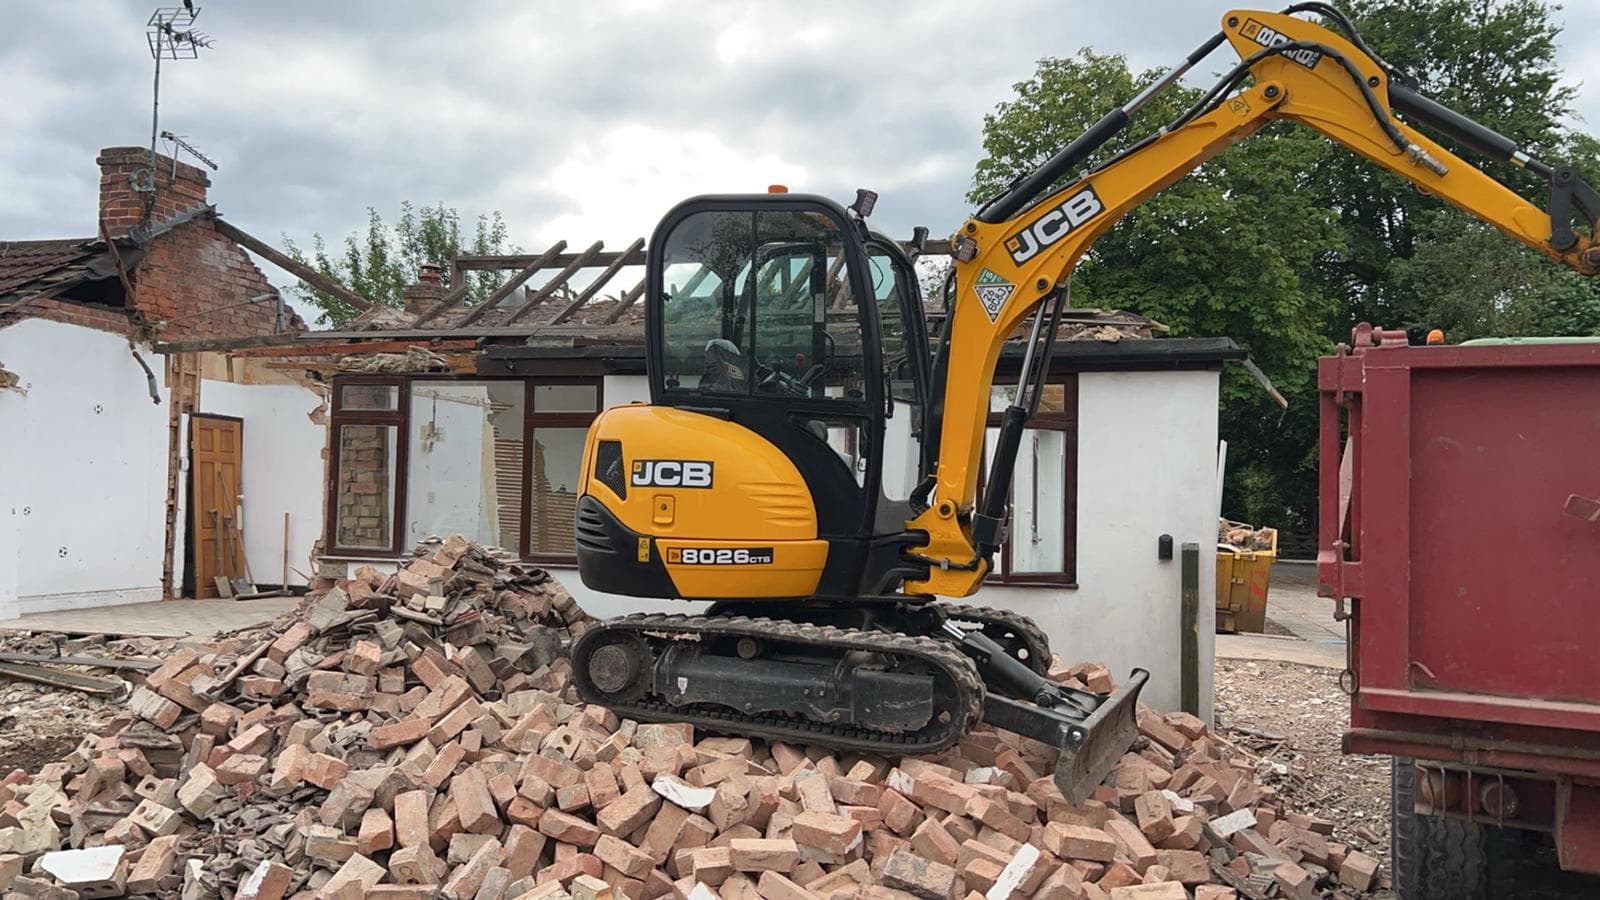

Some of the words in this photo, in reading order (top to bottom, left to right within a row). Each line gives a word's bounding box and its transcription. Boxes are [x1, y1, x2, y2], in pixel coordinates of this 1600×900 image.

[1013, 189, 1101, 263] JCB
[632, 461, 711, 487] JCB
[682, 549, 749, 564] 8026
